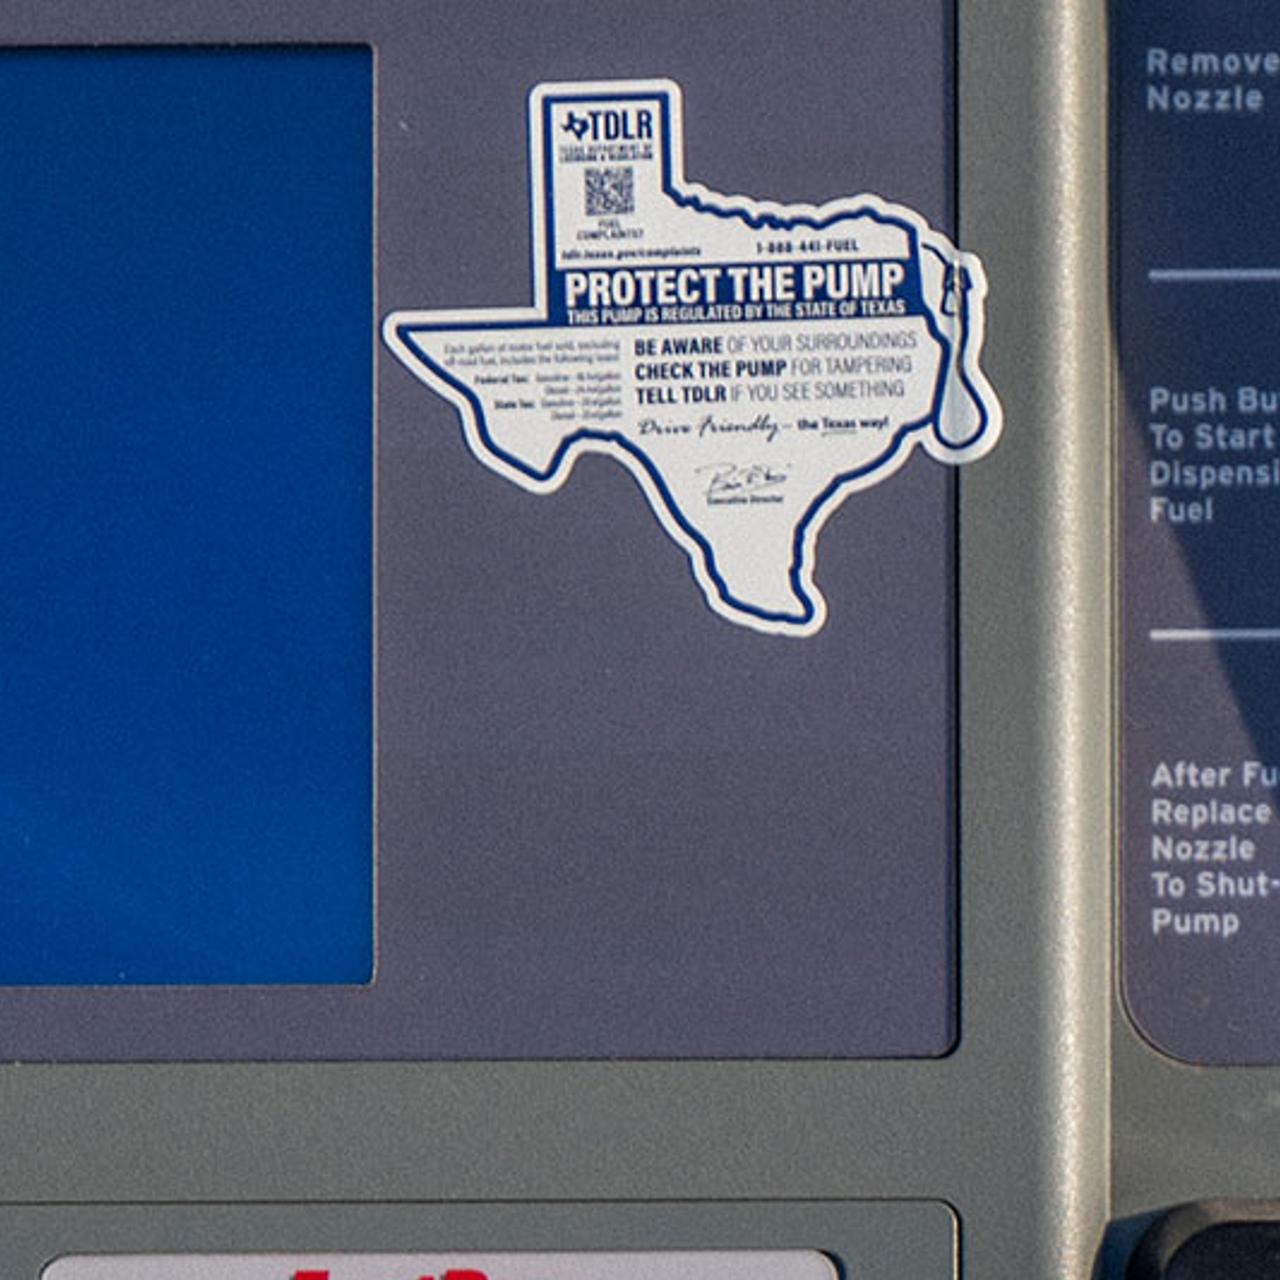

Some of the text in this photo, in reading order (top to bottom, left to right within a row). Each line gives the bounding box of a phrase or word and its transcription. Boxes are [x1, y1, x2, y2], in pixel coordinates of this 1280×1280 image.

[1146, 49, 1280, 74] Remove
[1146, 85, 1264, 111] Nozzle
[588, 110, 653, 140] TDLR
[566, 262, 905, 306] PROTECT THE PUMP
[568, 299, 906, 326] THIS PUMP IS REGULATED BY THE STATE OF TEXAS
[635, 331, 917, 355] BE AWARE OF YOUR SURROUNDINGS
[635, 362, 693, 380] CHECK
[699, 361, 730, 378] THE
[736, 359, 787, 377] PUMP
[791, 358, 821, 375] FOR
[826, 355, 912, 374] TAMPERING
[636, 387, 678, 404] TELL
[683, 385, 727, 402] TDLR
[731, 385, 743, 401] IF
[747, 383, 778, 401] YOU
[783, 382, 810, 400] SEE
[815, 380, 904, 399] SOMETHING
[1150, 387, 1226, 414] Push
[798, 419, 818, 431] the
[821, 418, 856, 431] Texas
[859, 417, 889, 430] way!
[1150, 424, 1275, 450] To Start
[1150, 497, 1213, 522] Fuel
[1151, 762, 1232, 788] After
[1151, 799, 1271, 828] Replace
[1151, 836, 1256, 861] Nozzle
[1151, 872, 1185, 897] To
[1151, 908, 1240, 937] Pump
